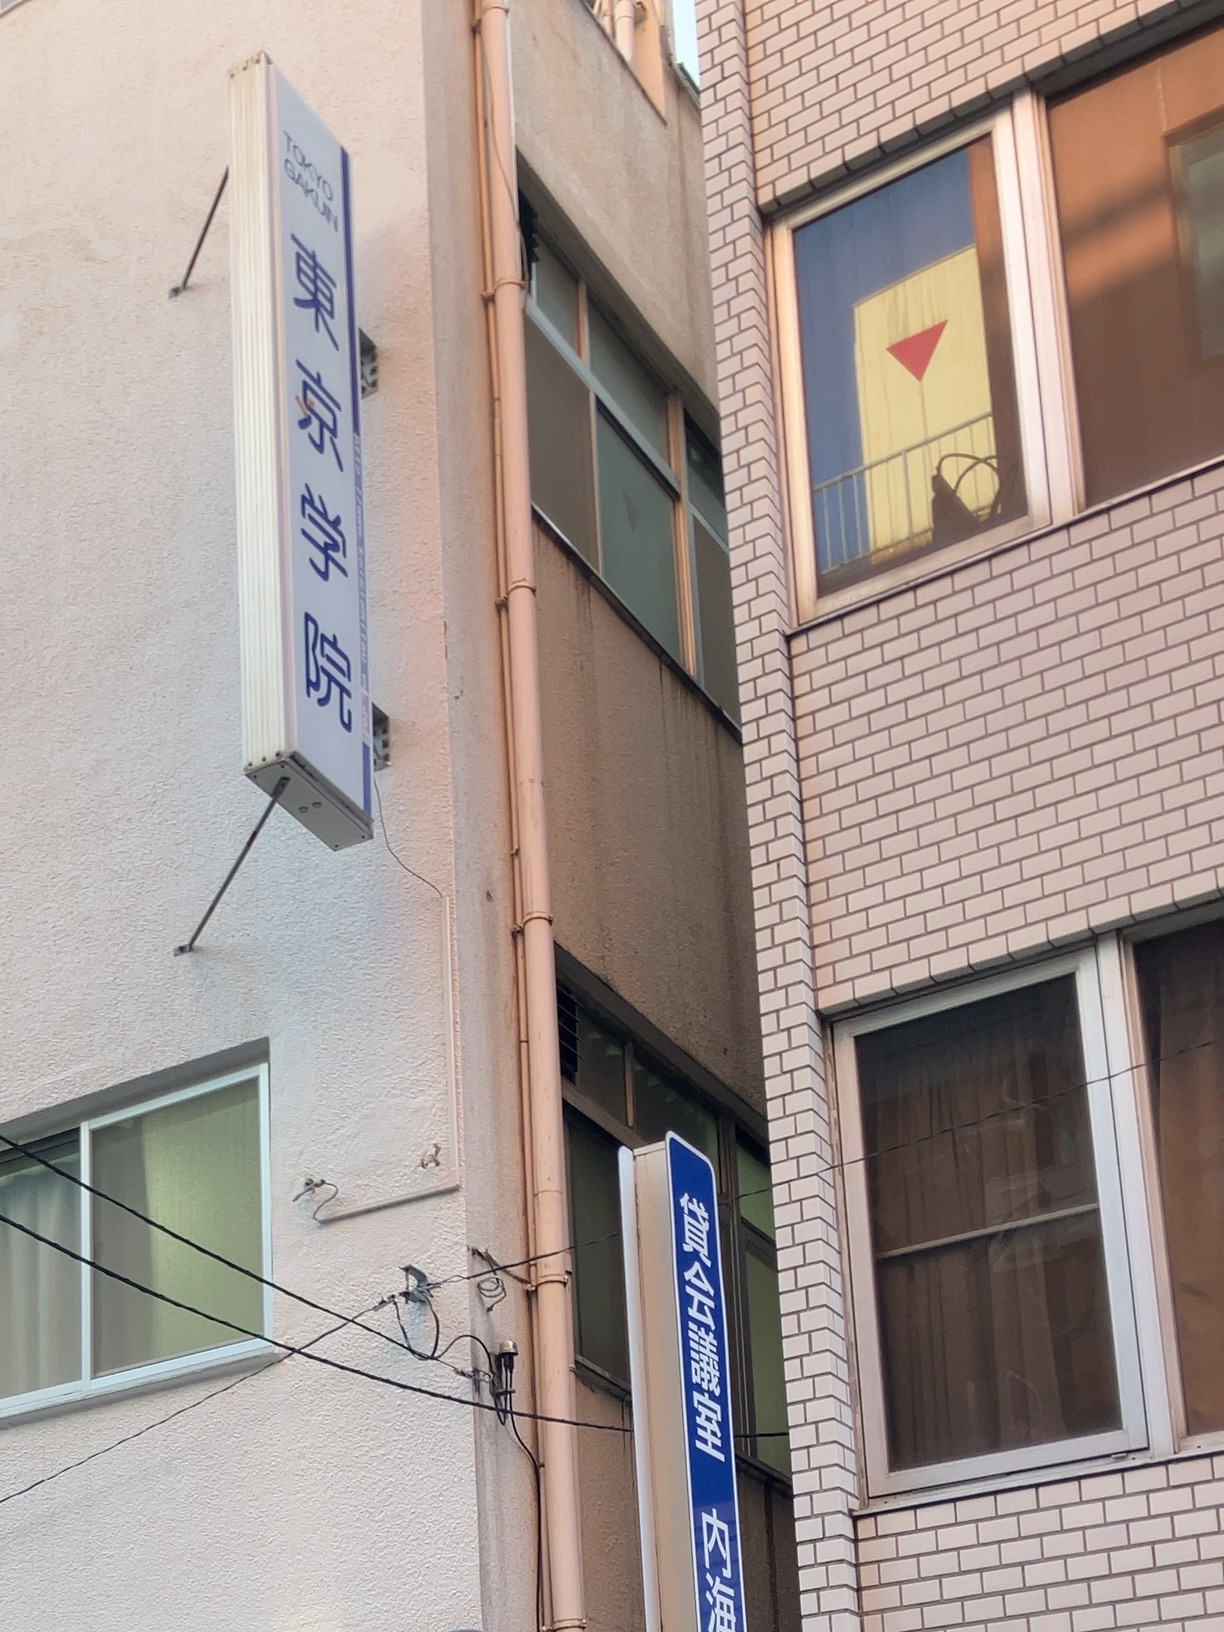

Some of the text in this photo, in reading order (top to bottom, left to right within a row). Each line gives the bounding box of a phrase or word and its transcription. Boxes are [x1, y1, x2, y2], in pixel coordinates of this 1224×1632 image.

[282, 130, 334, 202] TOKYO
[283, 158, 339, 233] GAKUIN
[290, 231, 352, 735] 東京学院
[679, 1192, 726, 1464] 貸会議室
